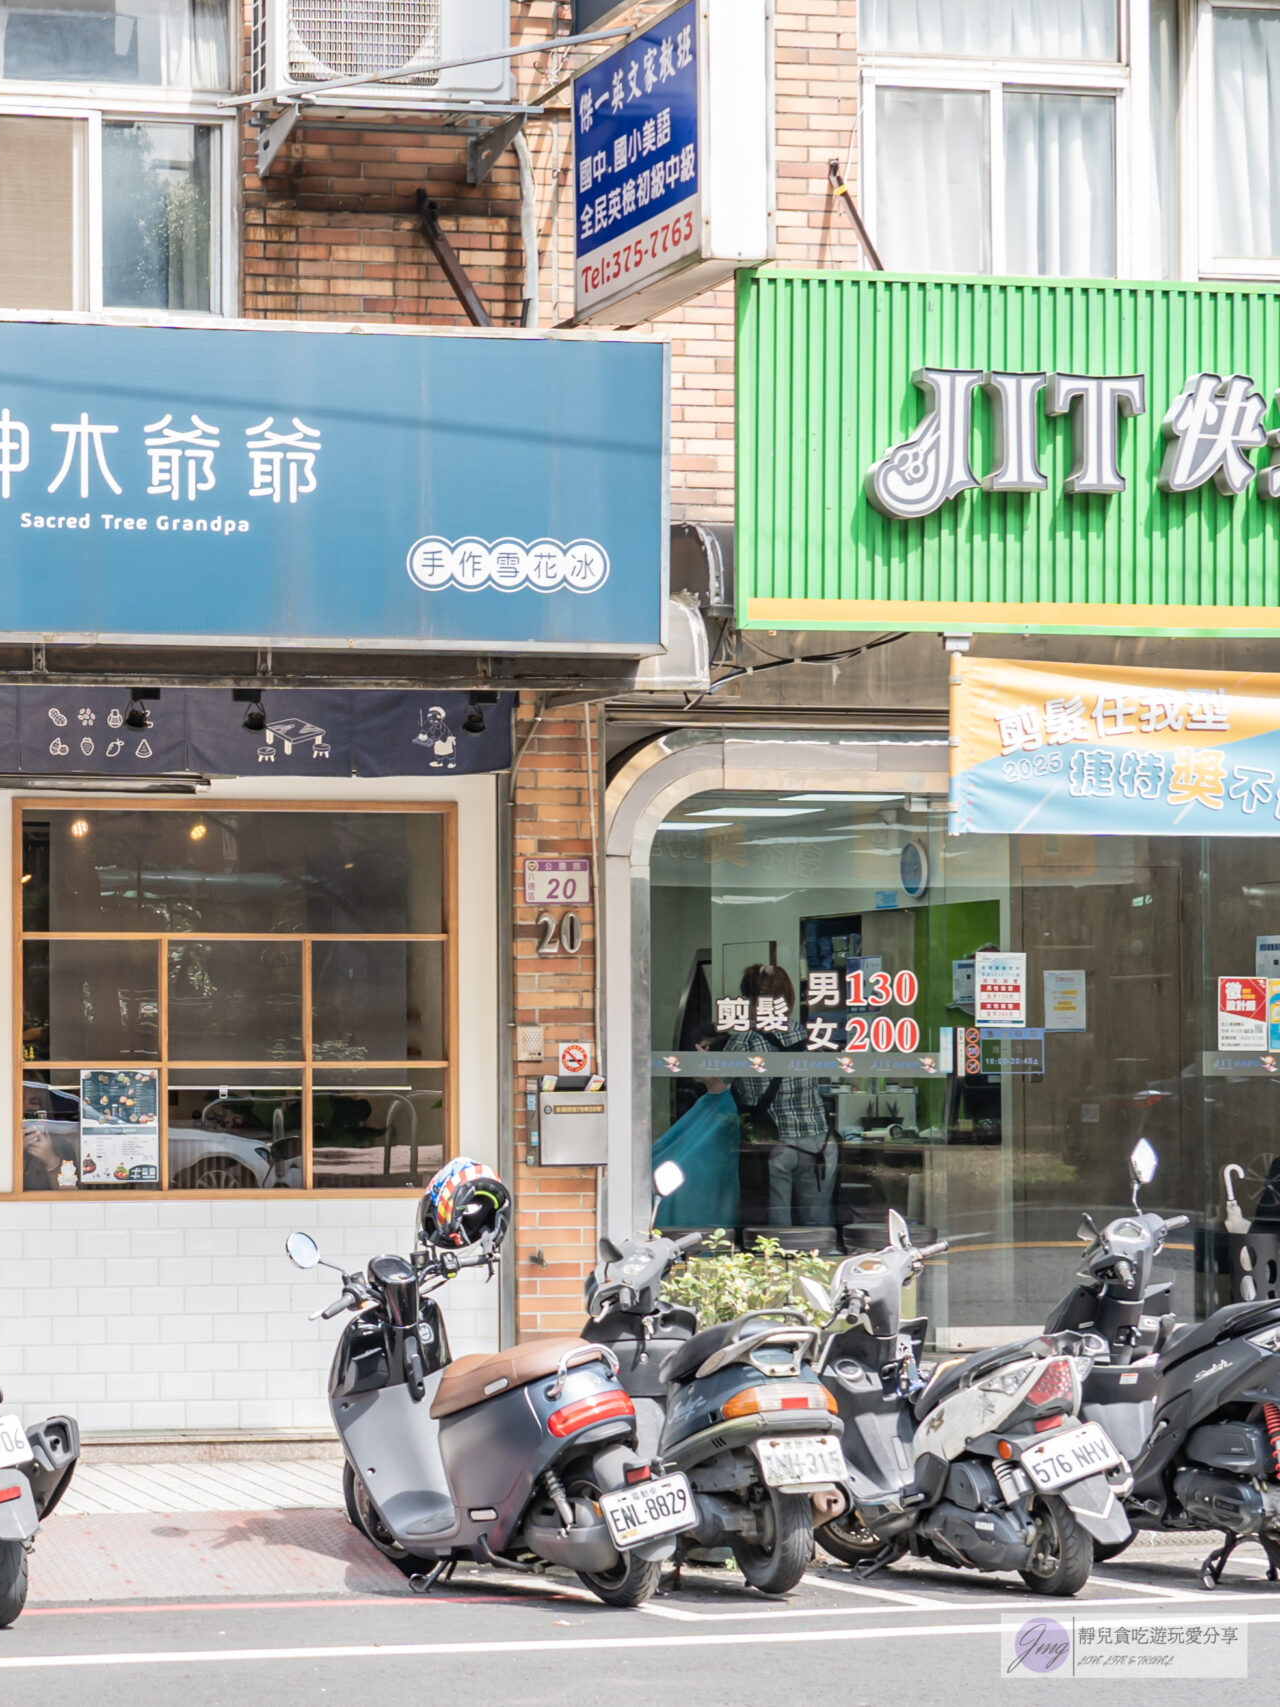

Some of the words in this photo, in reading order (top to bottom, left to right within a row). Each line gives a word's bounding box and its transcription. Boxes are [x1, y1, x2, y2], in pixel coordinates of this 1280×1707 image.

[579, 24, 693, 134] 傑一英文家教班
[580, 143, 695, 240] 全民英檢初級中級
[581, 210, 694, 294] Tel:375-7763
[865, 367, 1145, 520] JIT
[1159, 372, 1280, 500] 快
[20, 512, 92, 530] Sacred
[101, 514, 148, 531] Tree
[156, 515, 251, 536] Grandpa
[421, 550, 596, 580] 手作雪花冰
[993, 687, 1231, 757] 剪髮任我型
[1003, 751, 1064, 784] 2025
[1068, 746, 1280, 824] 捷特獎不
[546, 878, 577, 900] 20
[537, 911, 582, 954] 20
[716, 995, 790, 1032] 剪髮
[807, 971, 840, 1006] 男
[845, 969, 919, 1007] 130
[806, 1017, 839, 1052] 女
[845, 1016, 920, 1053] 200
